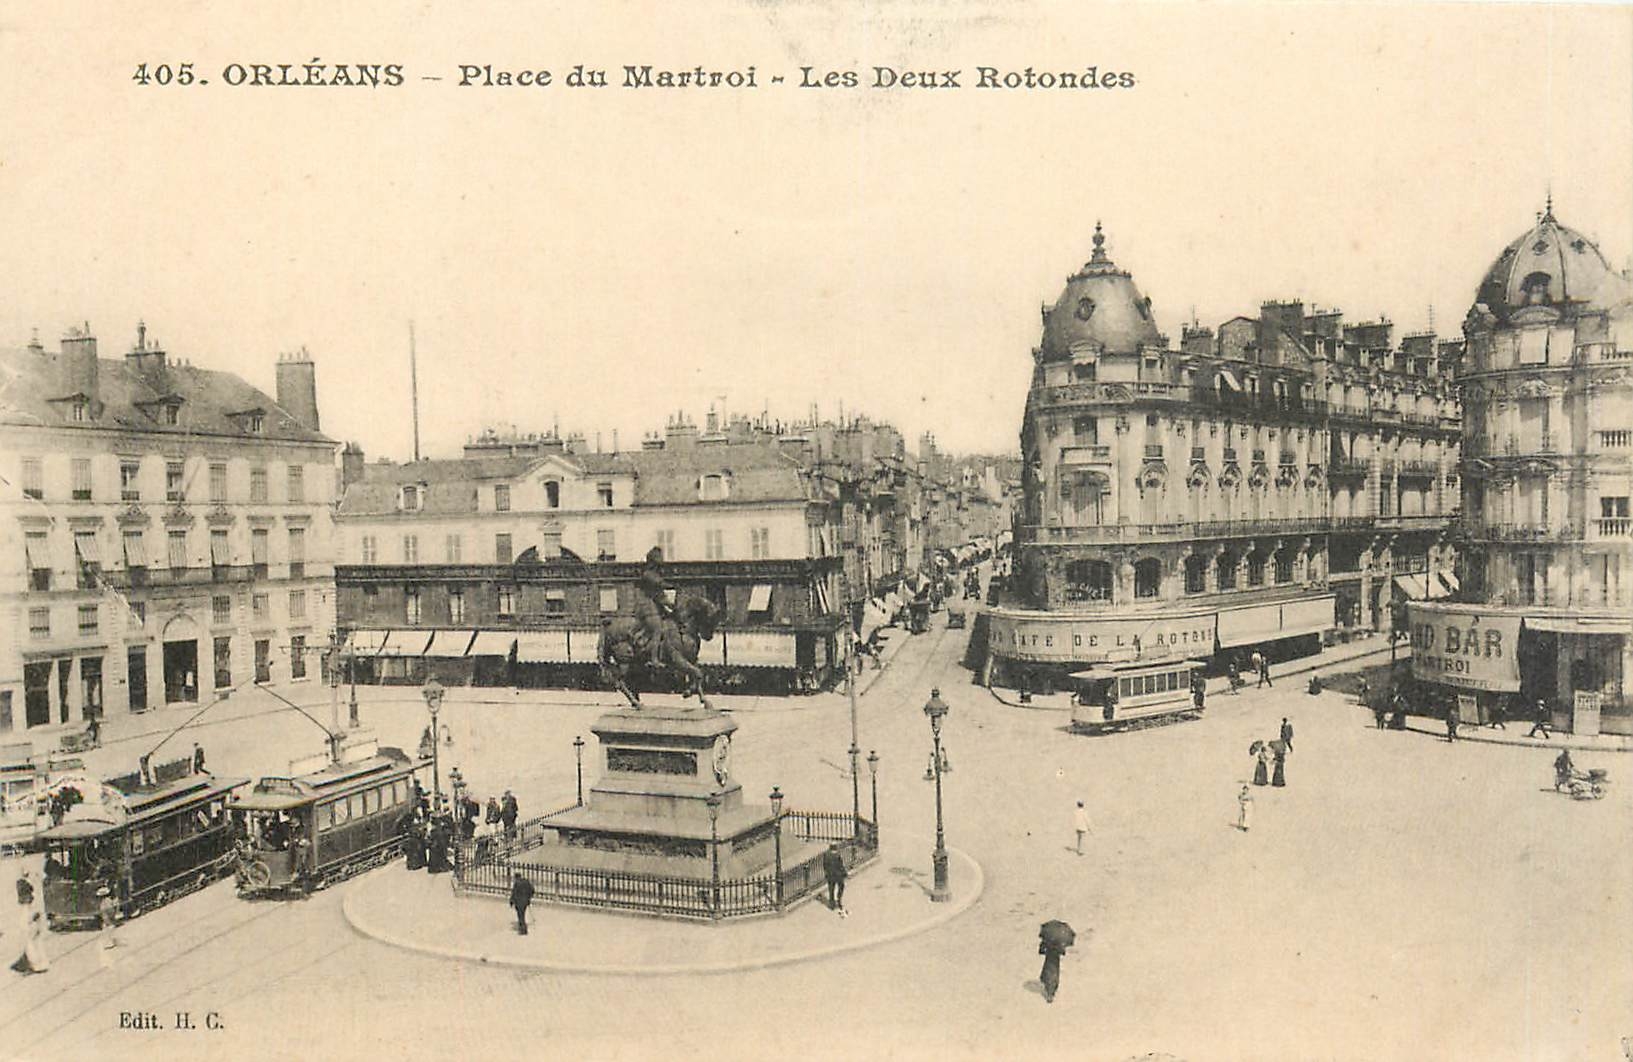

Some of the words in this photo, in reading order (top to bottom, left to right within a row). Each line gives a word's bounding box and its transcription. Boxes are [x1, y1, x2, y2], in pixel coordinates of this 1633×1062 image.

[1075, 634, 1098, 647] DE
[1117, 634, 1140, 647] LA
[1445, 626, 1502, 658] BAR
